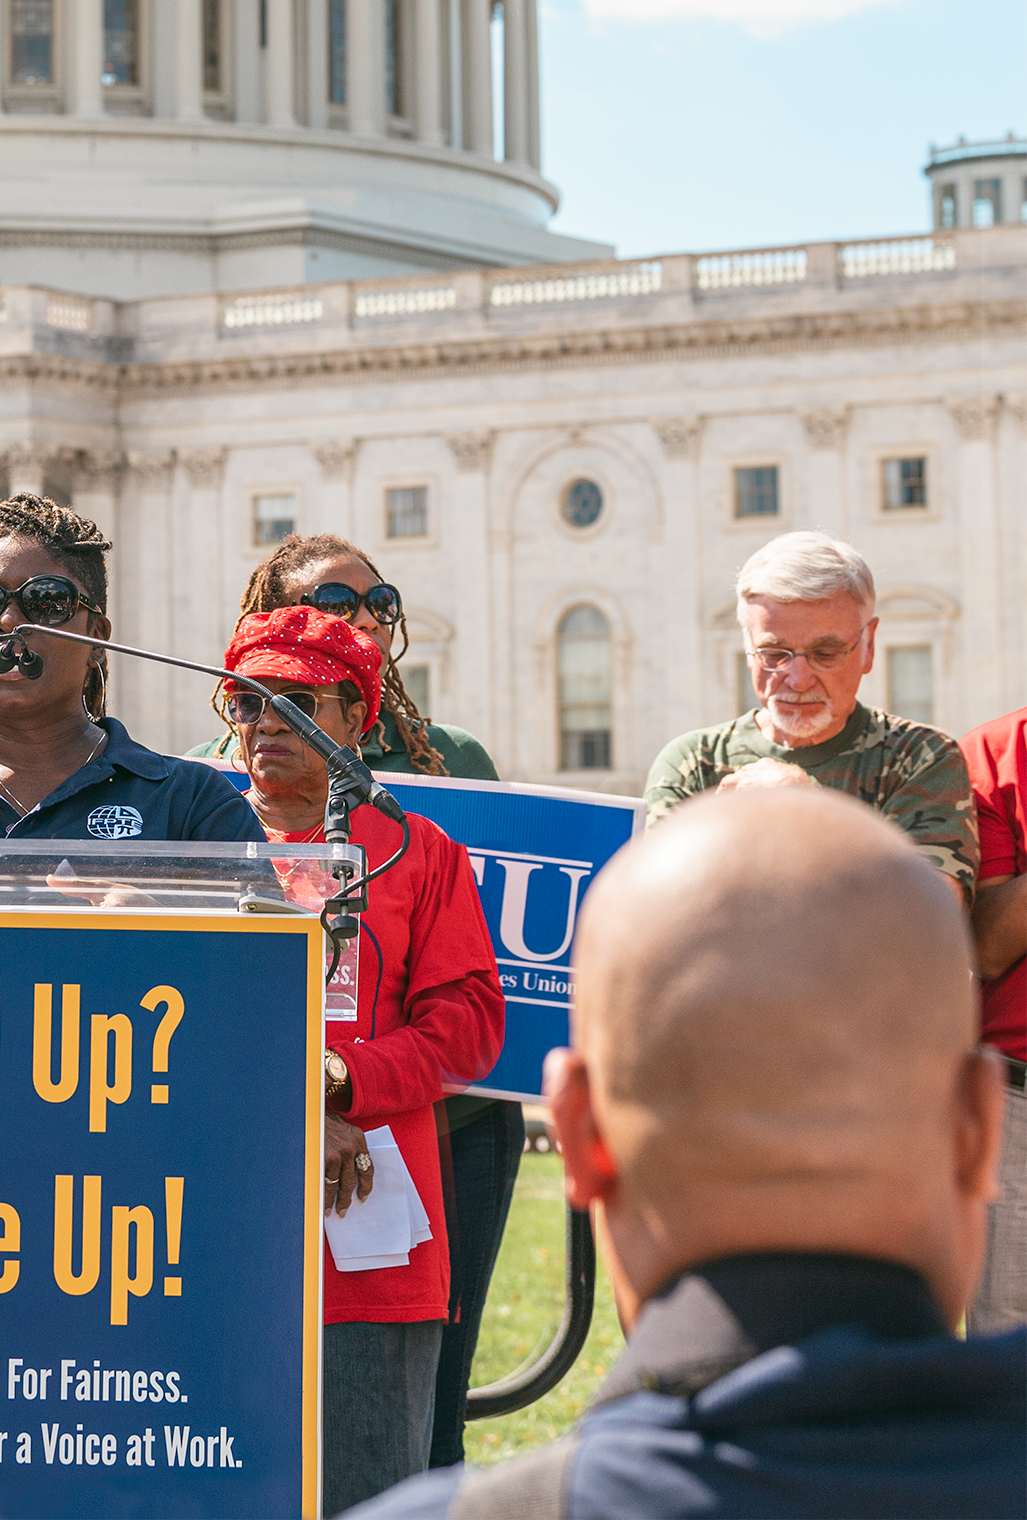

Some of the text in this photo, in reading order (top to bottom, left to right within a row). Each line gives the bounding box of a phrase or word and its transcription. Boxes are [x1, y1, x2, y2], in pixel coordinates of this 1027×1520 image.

[469, 855, 591, 962] U
[522, 972, 577, 996] Union
[32, 982, 186, 1133] Up?
[53, 1174, 185, 1326] Up!
[6, 1357, 53, 1401] For
[59, 1358, 189, 1404] Fairness.
[15, 1432, 32, 1464] a
[40, 1422, 118, 1466] Voice
[125, 1427, 156, 1467] at
[163, 1425, 243, 1468] Work.
